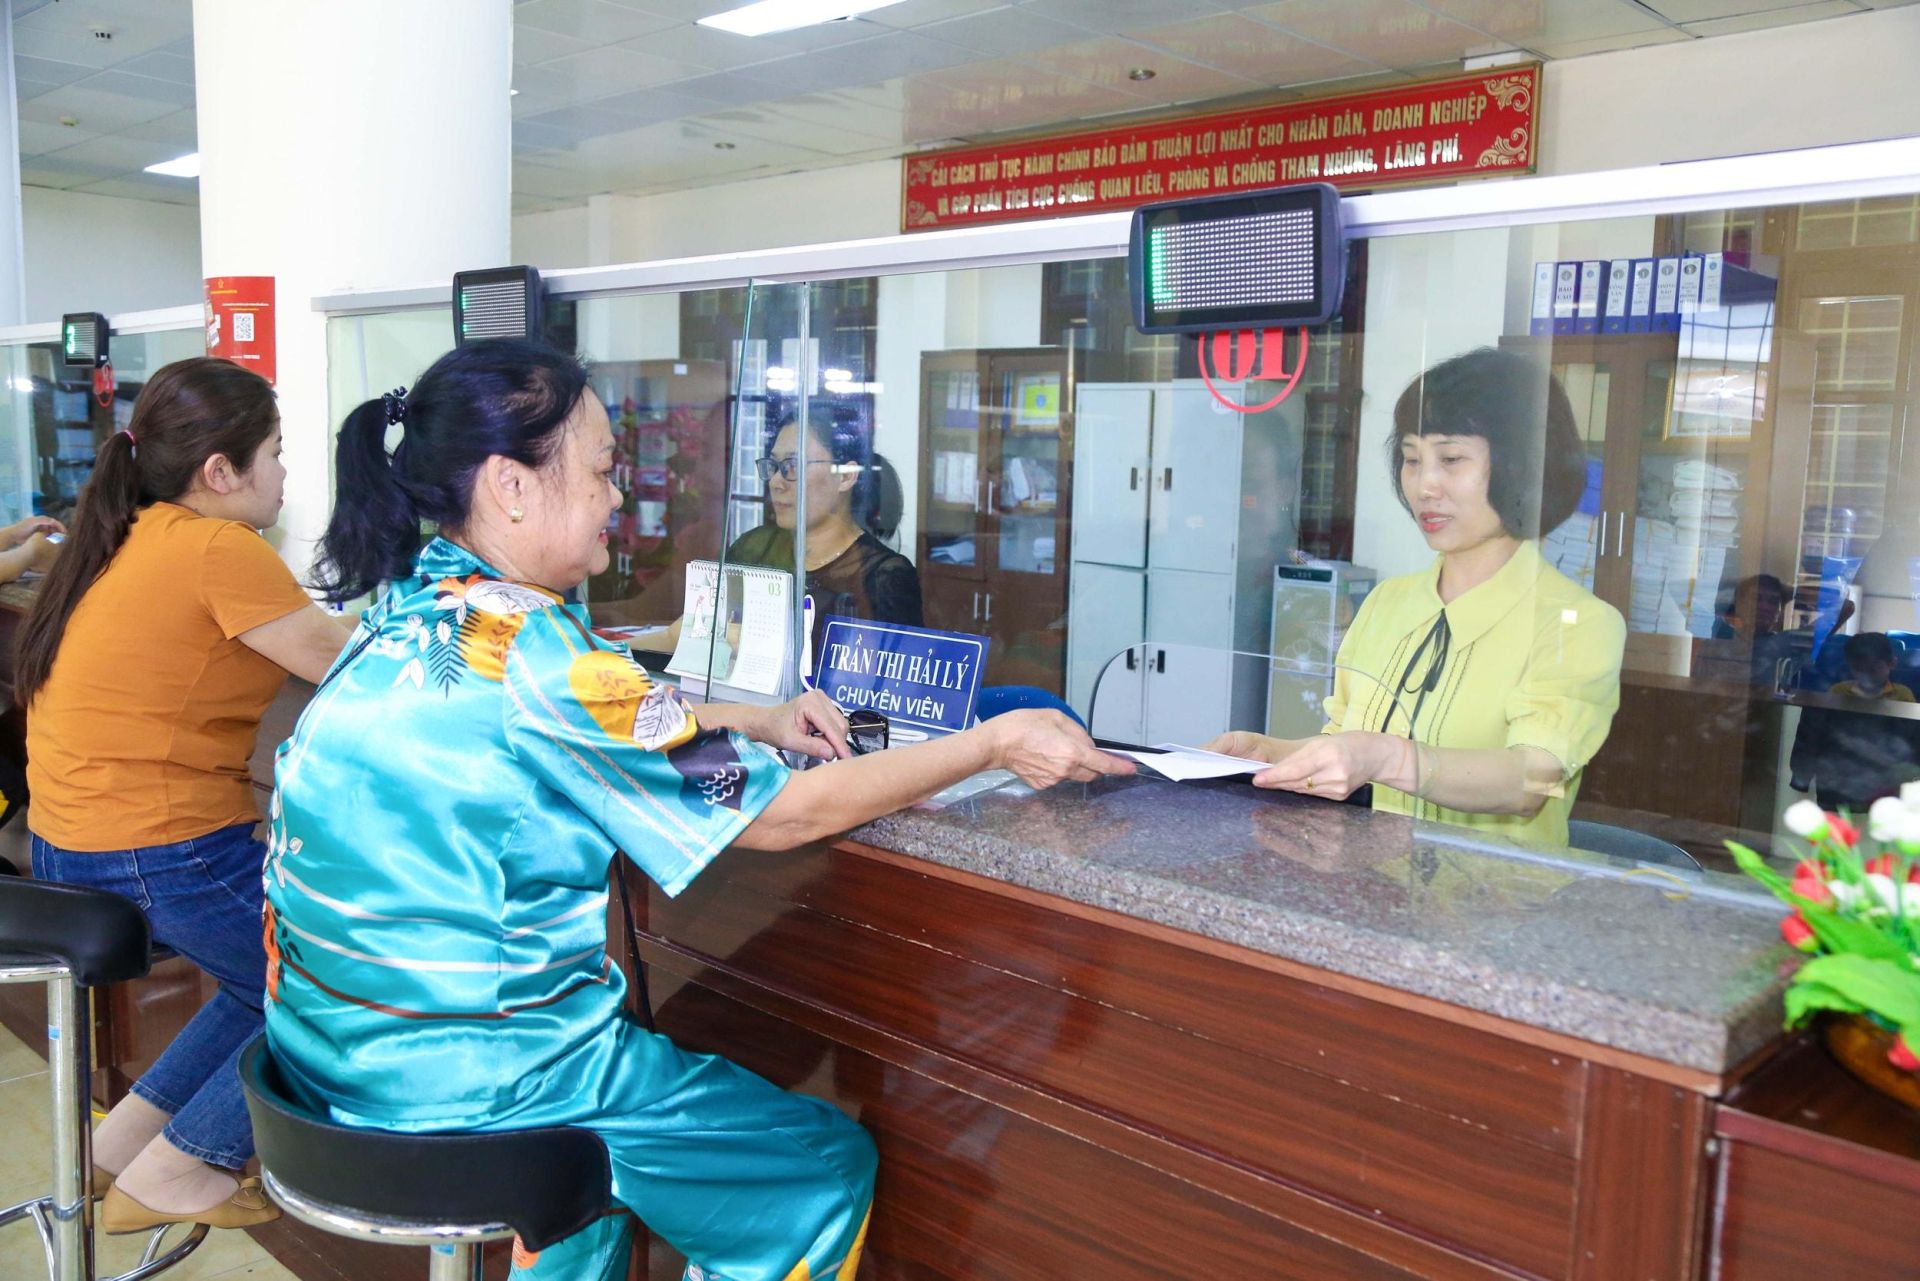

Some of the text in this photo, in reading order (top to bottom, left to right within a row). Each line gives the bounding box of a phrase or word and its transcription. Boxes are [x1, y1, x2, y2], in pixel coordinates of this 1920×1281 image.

[950, 161, 976, 185] CÁCH
[979, 153, 999, 182] THỦ
[1002, 158, 1021, 183] TỤC
[1024, 152, 1054, 176] HÀNH
[1057, 147, 1090, 172] CHÍNH
[1093, 139, 1117, 168] BẢO
[1152, 132, 1192, 162] THUẬN
[1196, 129, 1216, 158] LỢI
[1220, 119, 1253, 152] NHẤT
[1258, 122, 1284, 147] CHO
[1289, 113, 1328, 143] NHÂN
[1333, 108, 1367, 137] DÂN,
[1372, 103, 1424, 133] DOANH
[1429, 91, 1487, 126] NGHIỆP
[1005, 186, 1030, 210] TÍCH
[1058, 175, 1095, 205] CHỐNG
[1100, 176, 1131, 202] QUAN
[1135, 169, 1164, 196] LIÊU,
[1168, 164, 1209, 193] PHÒNG
[1214, 161, 1228, 188] VÀ
[1232, 153, 1275, 186] CHỐNG
[1281, 155, 1320, 180] THAM
[1323, 146, 1378, 177] NHŨNG,
[1384, 140, 1426, 170] LÃNG
[1431, 132, 1463, 165] PHÍ.
[767, 582, 781, 597] 03
[829, 633, 969, 690] TRẦN THỊ HẢI LÝ
[836, 685, 945, 721] CHUYÊN VIÊN
